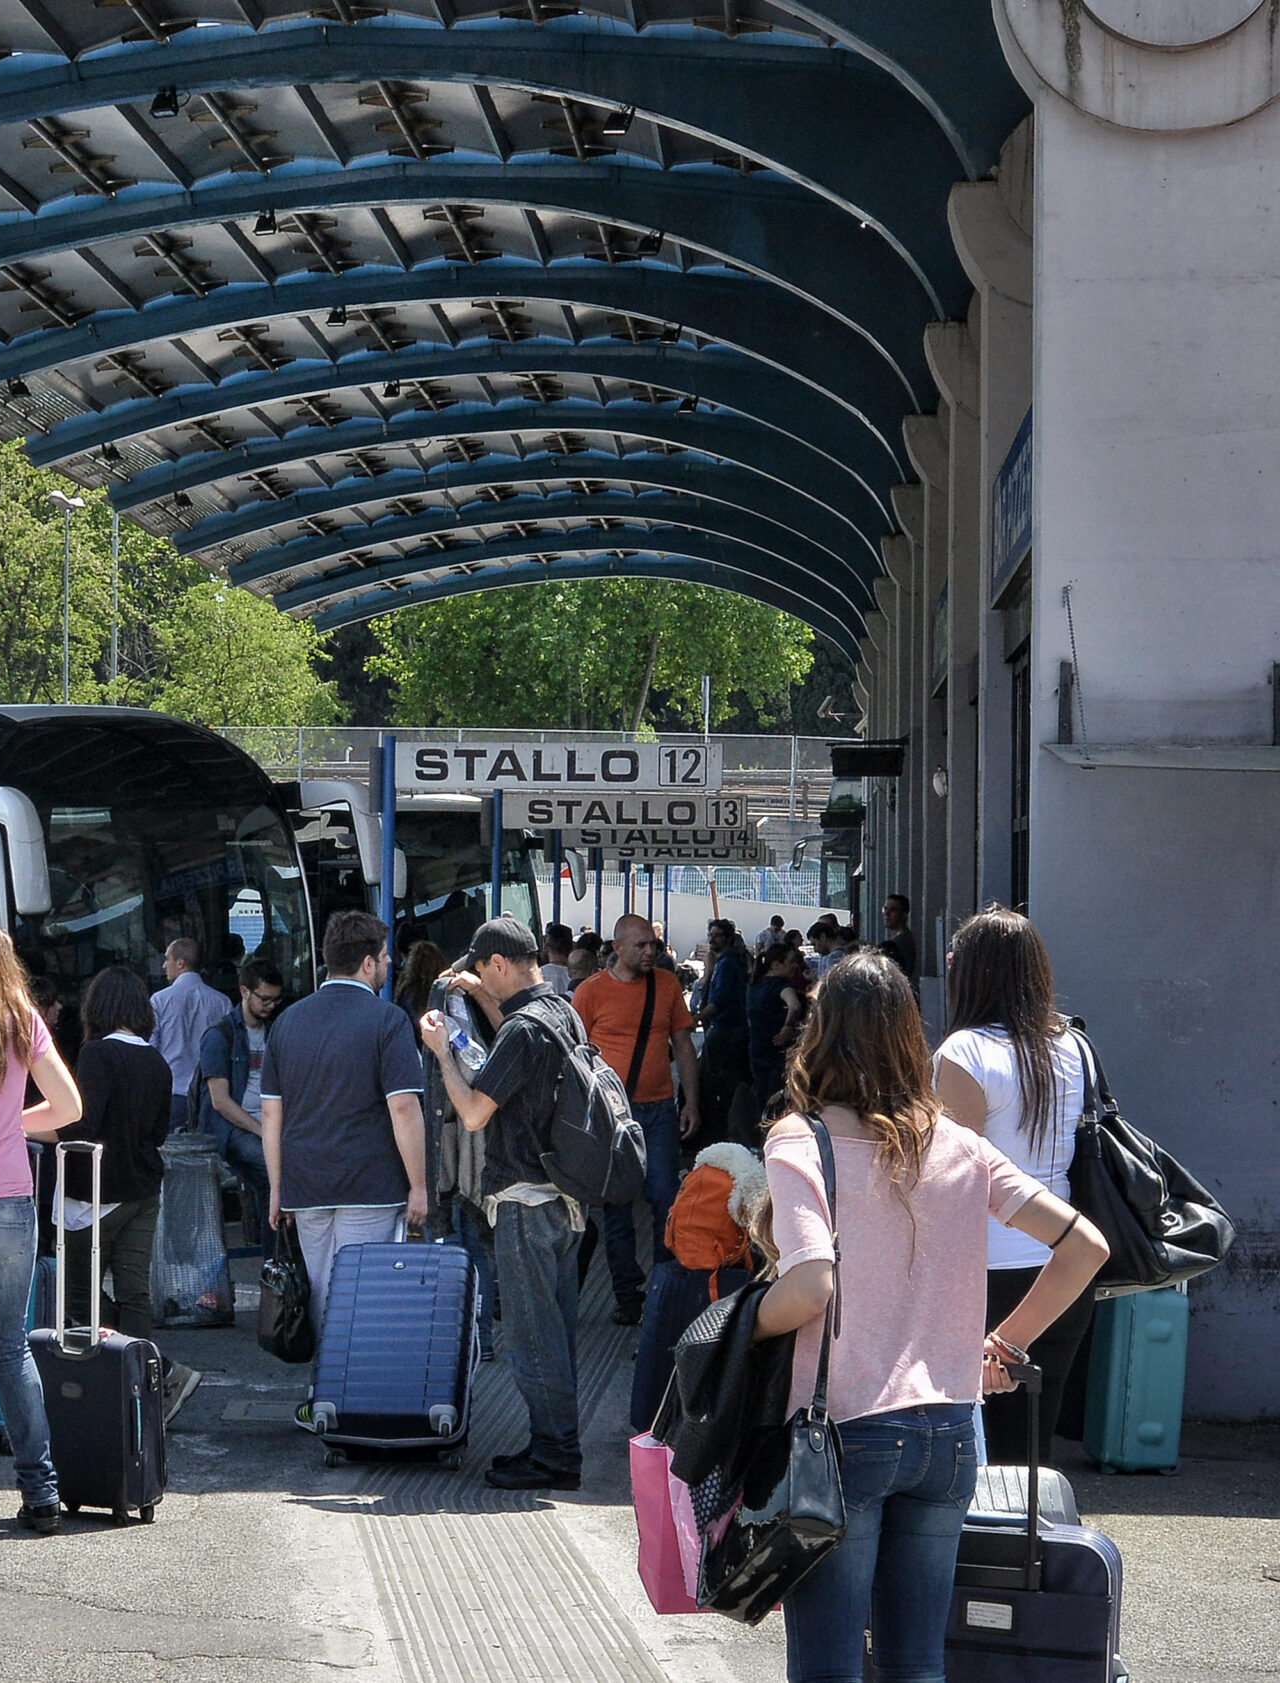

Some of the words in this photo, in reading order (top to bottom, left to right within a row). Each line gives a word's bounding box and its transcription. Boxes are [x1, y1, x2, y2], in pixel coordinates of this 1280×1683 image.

[414, 748, 640, 783] STALLO
[663, 748, 702, 784] 12
[527, 798, 697, 826] STALLO
[710, 799, 739, 827] 13
[580, 828, 716, 845] STALLO
[728, 829, 750, 846] 14
